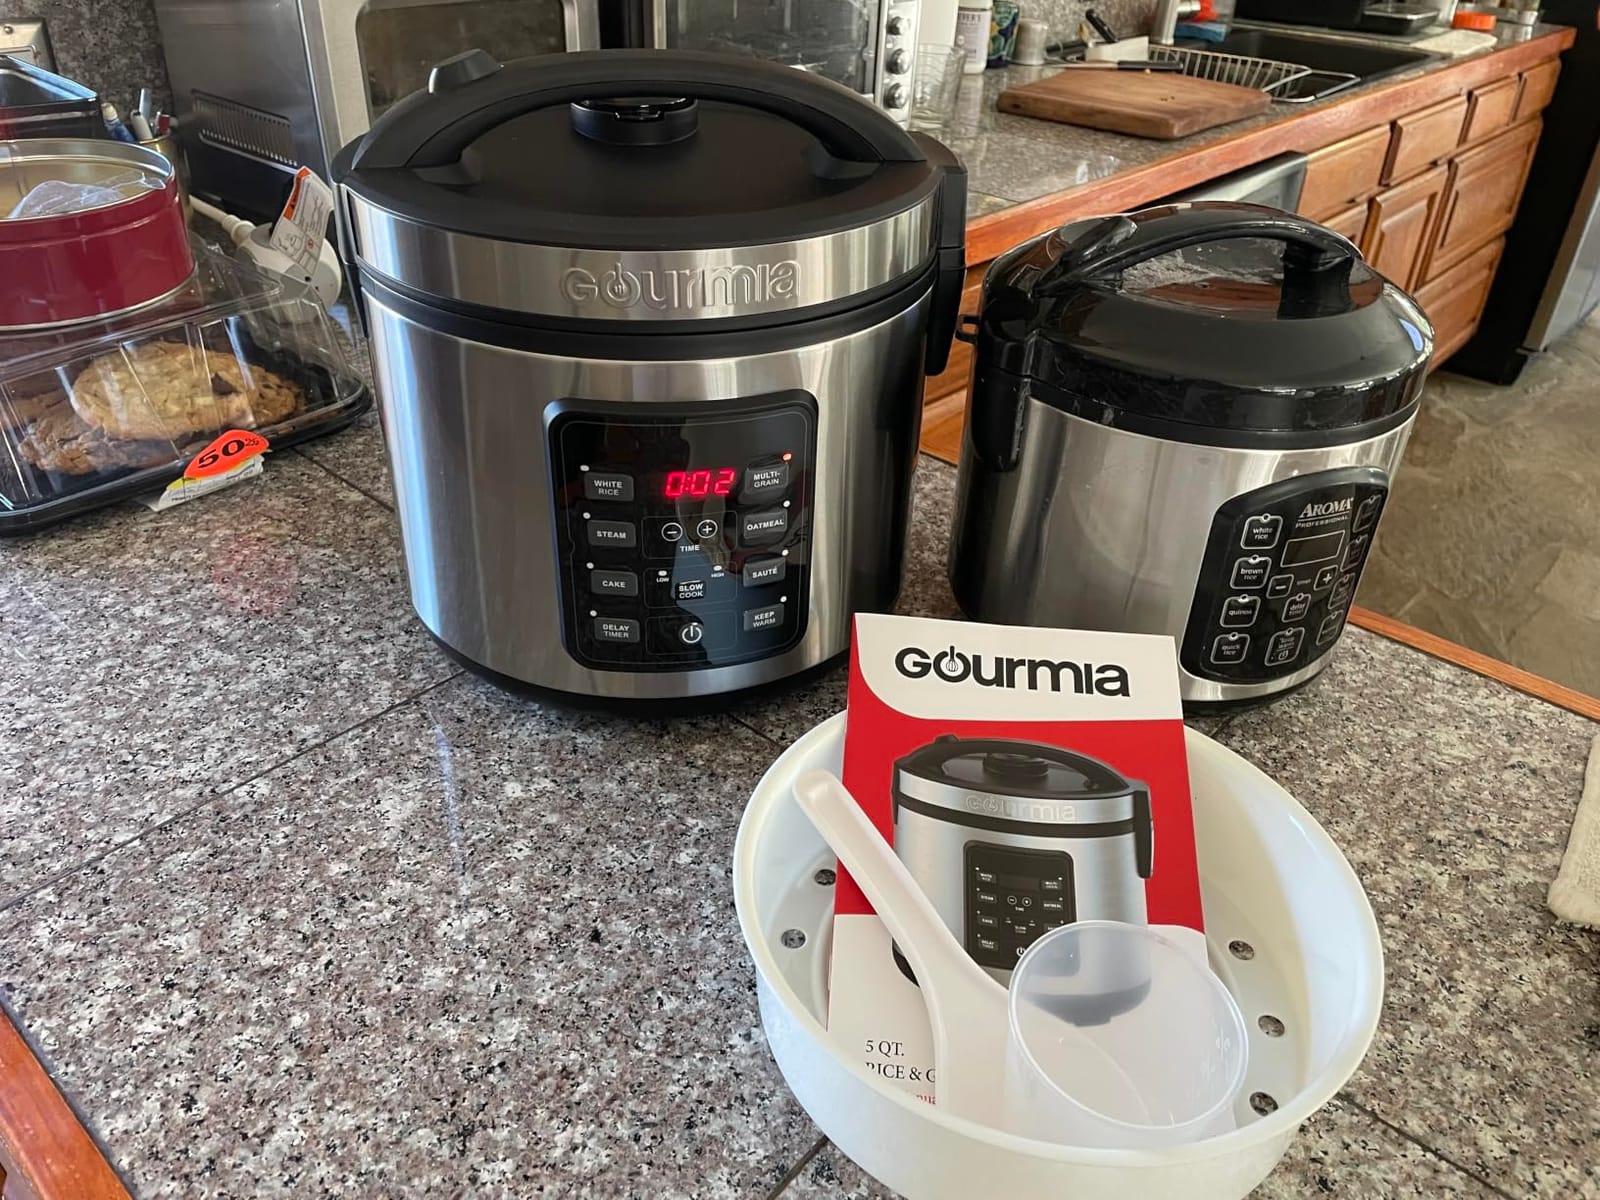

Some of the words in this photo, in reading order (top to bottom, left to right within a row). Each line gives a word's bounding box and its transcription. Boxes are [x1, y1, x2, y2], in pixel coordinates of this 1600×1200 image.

[560, 259, 802, 312] Gourmia
[753, 471, 781, 481] MULTI-
[593, 479, 623, 489] WHITE
[754, 478, 779, 488] GRAIN
[598, 488, 620, 496] RICE
[1299, 498, 1353, 518] AROMA
[746, 518, 785, 531] OATMEAL
[596, 530, 627, 539] STEAM
[680, 544, 701, 553] TIME
[602, 580, 626, 588] CAKE
[678, 583, 704, 592] SLOW
[679, 590, 704, 599] COOK
[754, 610, 775, 621] KEEP
[602, 623, 630, 631] DELAY
[752, 618, 776, 628] WARM
[603, 630, 629, 639] TIMER
[894, 645, 1131, 698] Gourmia
[865, 1040, 874, 1053] 5
[878, 1040, 905, 1058] QT.
[909, 1066, 922, 1081] &
